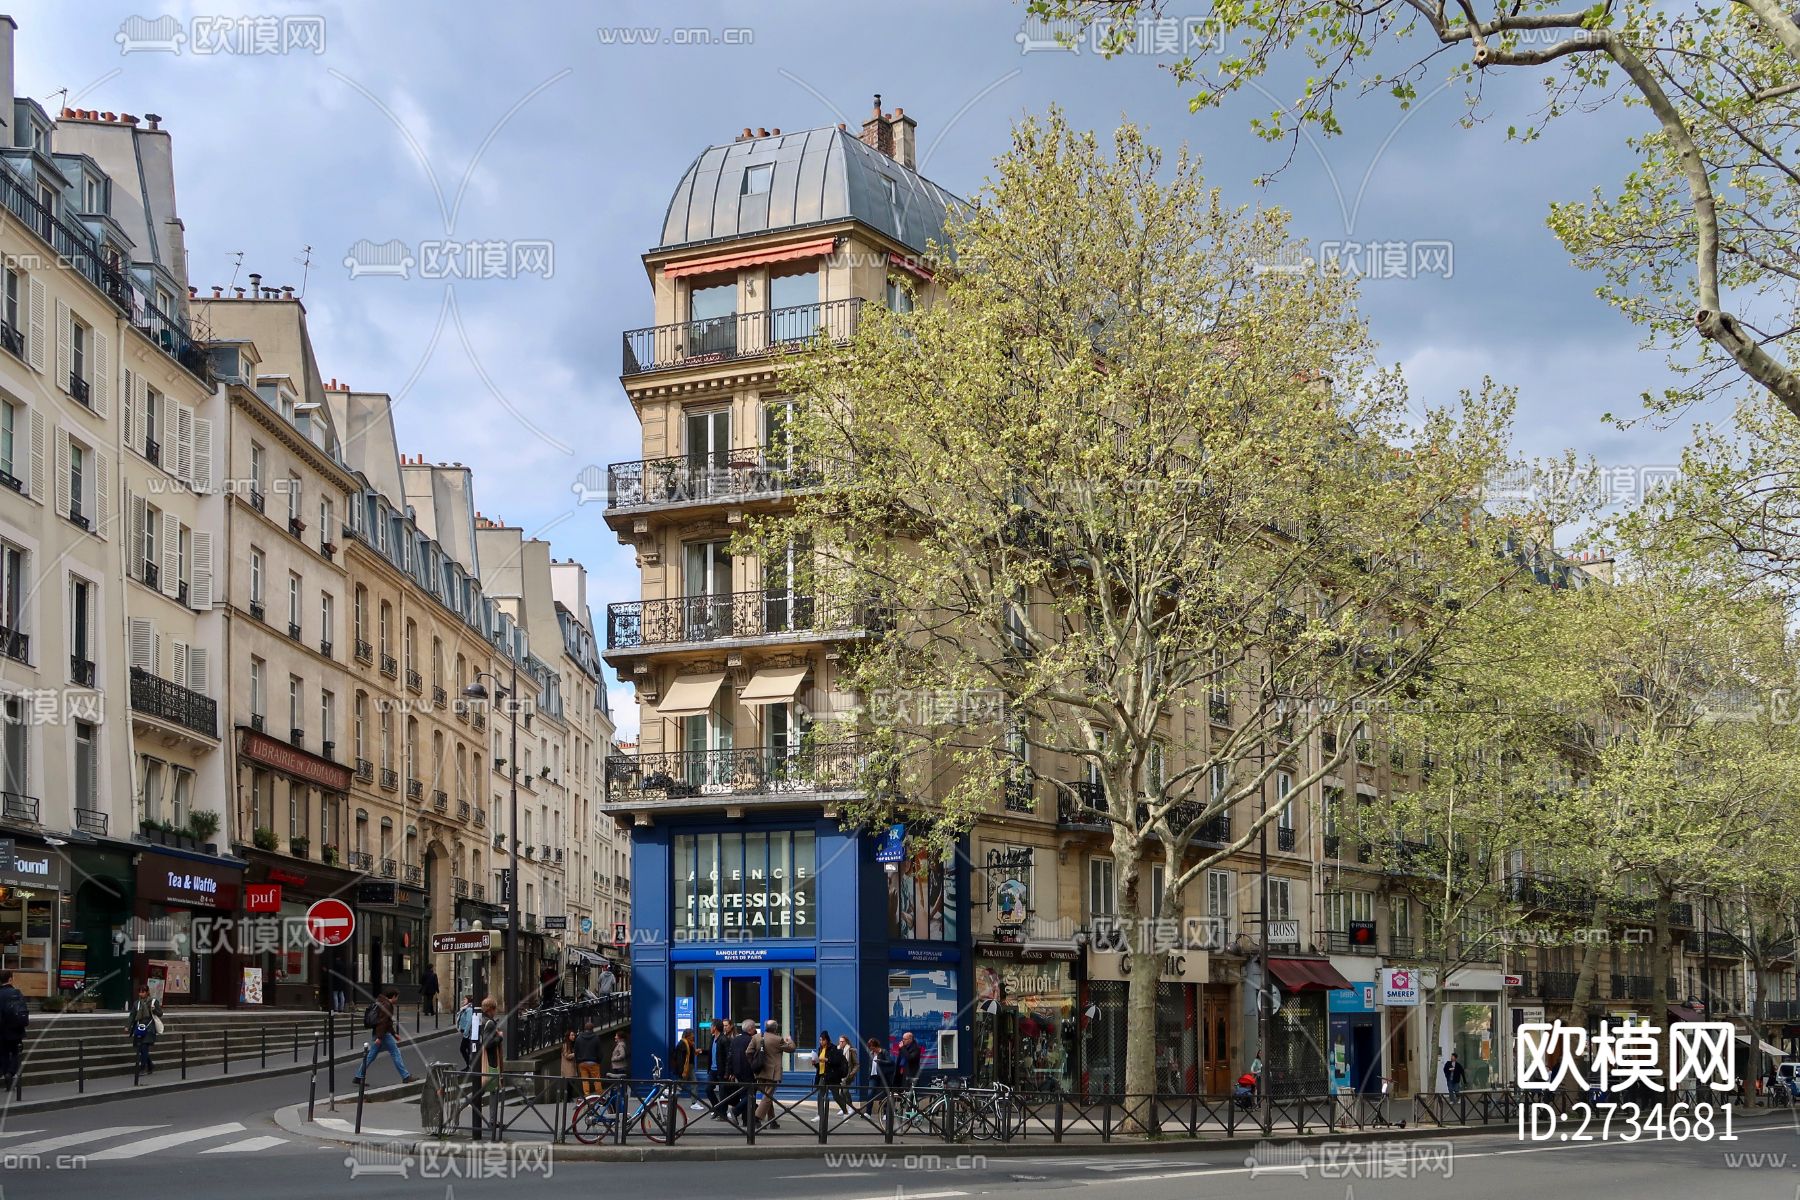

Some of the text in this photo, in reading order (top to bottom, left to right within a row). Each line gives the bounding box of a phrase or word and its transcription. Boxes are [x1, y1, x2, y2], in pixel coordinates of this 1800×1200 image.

[253, 740, 296, 768] LIBRAIRIE
[168, 871, 217, 894] Tea & Waffle
[688, 867, 806, 881] AGENCE
[251, 889, 276, 907] puf
[687, 891, 806, 909] PROFESSIONS
[687, 910, 806, 927] LIBERALES
[1267, 922, 1296, 937] CROSS
[1004, 971, 1051, 994] Simon
